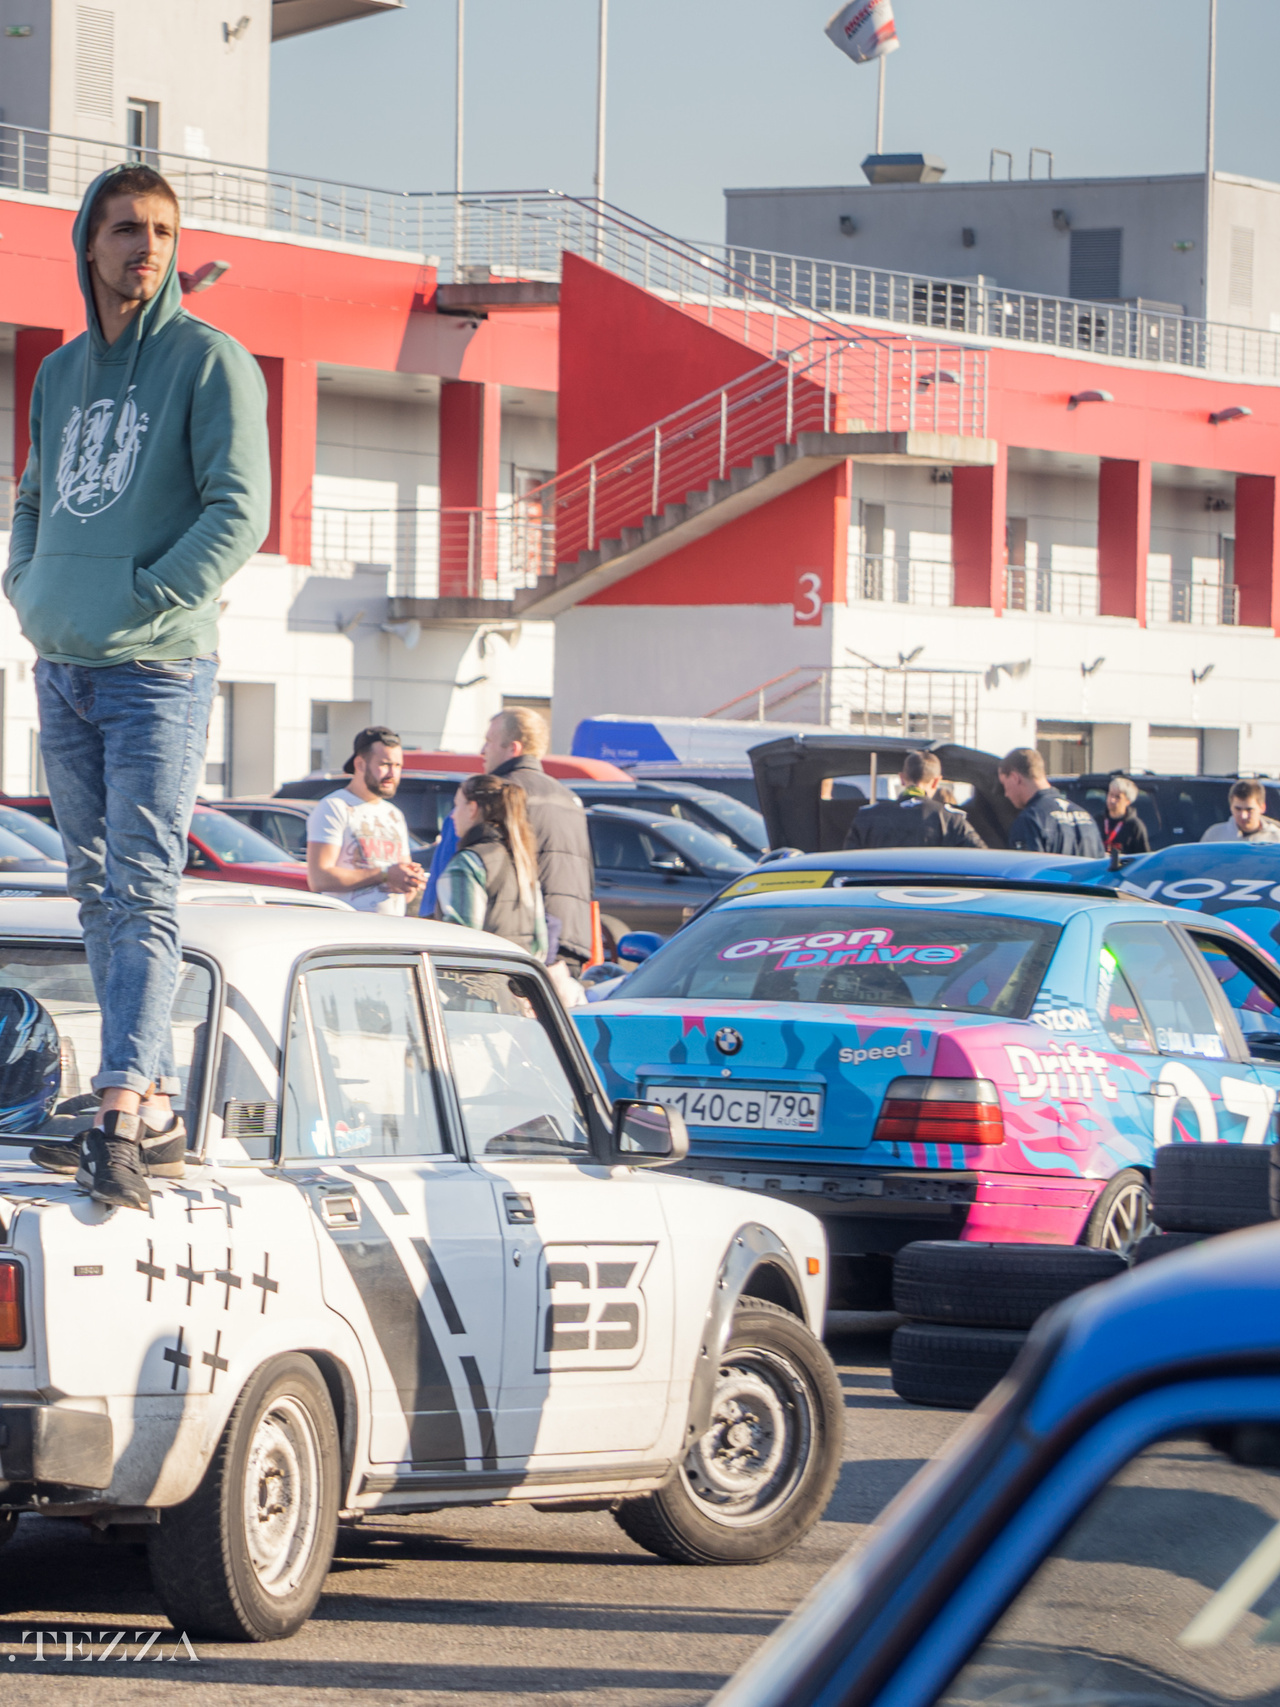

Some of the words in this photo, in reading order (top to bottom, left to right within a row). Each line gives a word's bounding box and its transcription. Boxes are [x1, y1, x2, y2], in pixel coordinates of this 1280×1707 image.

[795, 572, 822, 621] 3
[782, 944, 956, 968] Drive
[1032, 1008, 1092, 1031] OZON
[838, 1040, 912, 1065] Speed
[1002, 1040, 1118, 1100] Drift
[769, 1094, 812, 1119] 790
[777, 1117, 799, 1128] RUS
